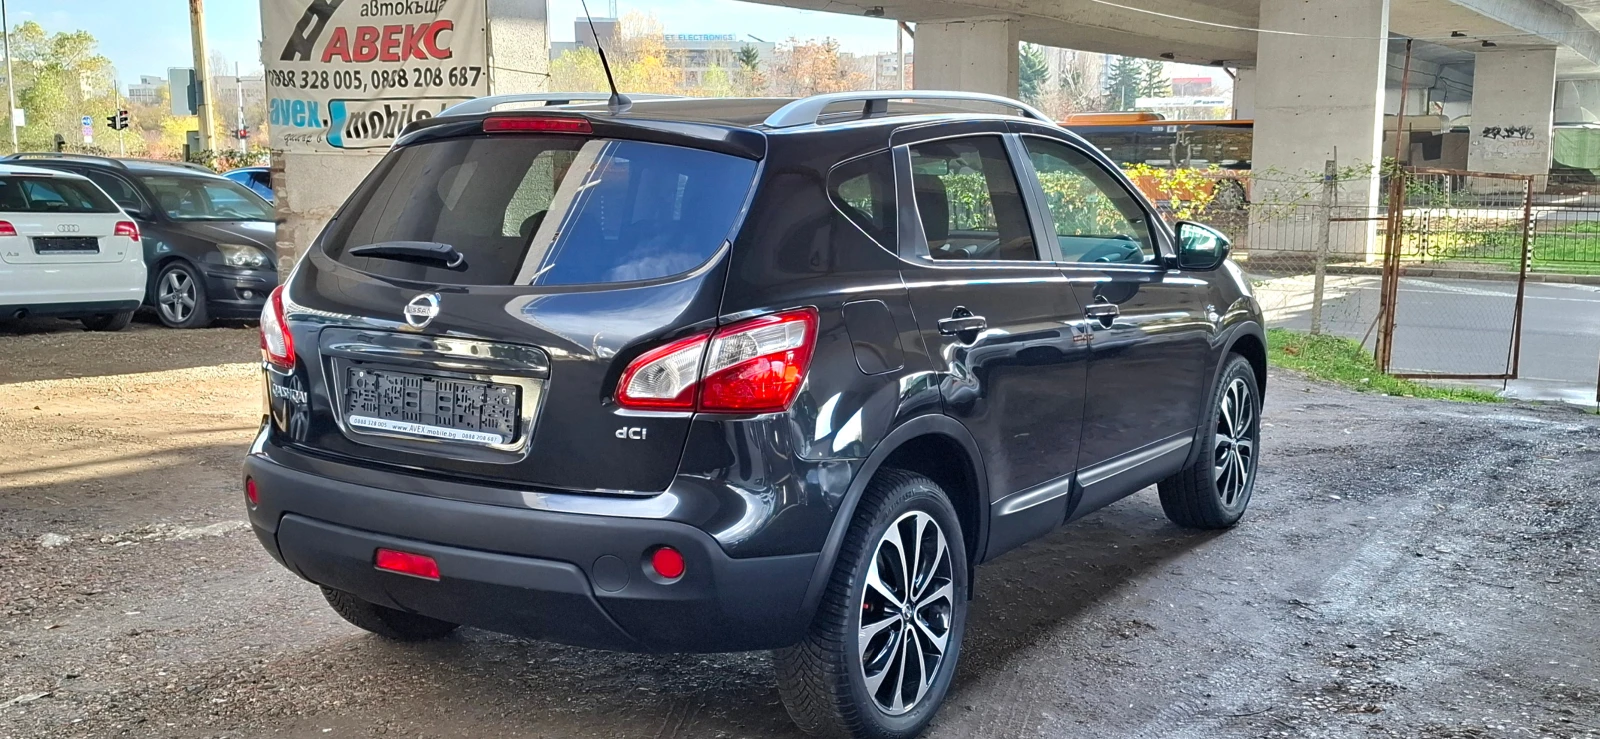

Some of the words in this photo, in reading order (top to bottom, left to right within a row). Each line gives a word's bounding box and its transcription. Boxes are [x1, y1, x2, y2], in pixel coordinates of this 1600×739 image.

[361, 0, 444, 17] автокъща
[321, 20, 454, 63] АВЕКС
[300, 70, 329, 89] 328
[333, 70, 367, 92] 005,
[371, 68, 408, 89] 0888
[413, 67, 443, 87] 208
[448, 66, 481, 87] 687
